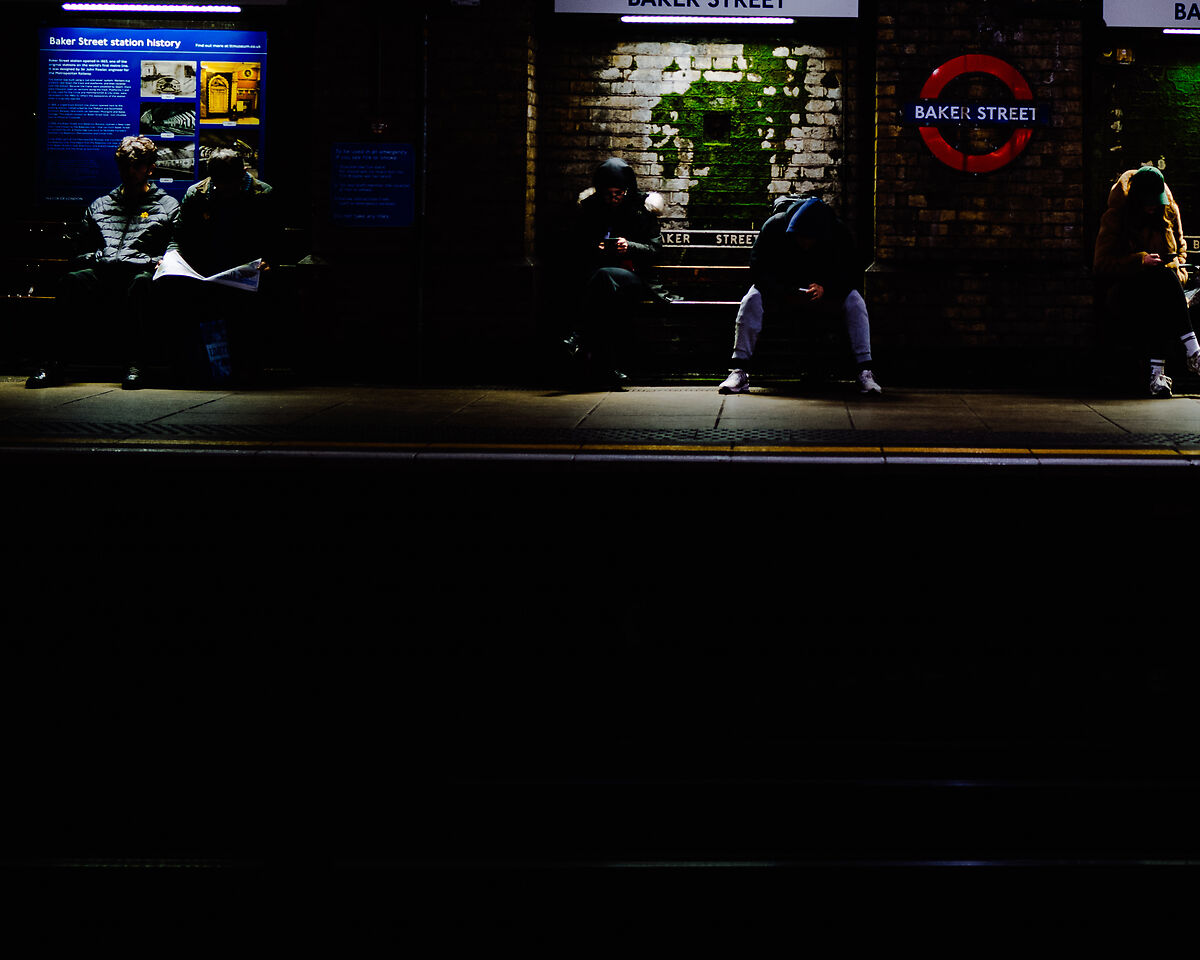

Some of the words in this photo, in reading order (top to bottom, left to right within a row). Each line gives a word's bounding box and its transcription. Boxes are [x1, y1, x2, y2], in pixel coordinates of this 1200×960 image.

[49, 36, 76, 46] Baker
[78, 36, 109, 47] Street
[109, 38, 144, 48] station
[146, 38, 182, 50] history
[915, 105, 971, 120] BAKER
[977, 106, 1037, 121] STREET
